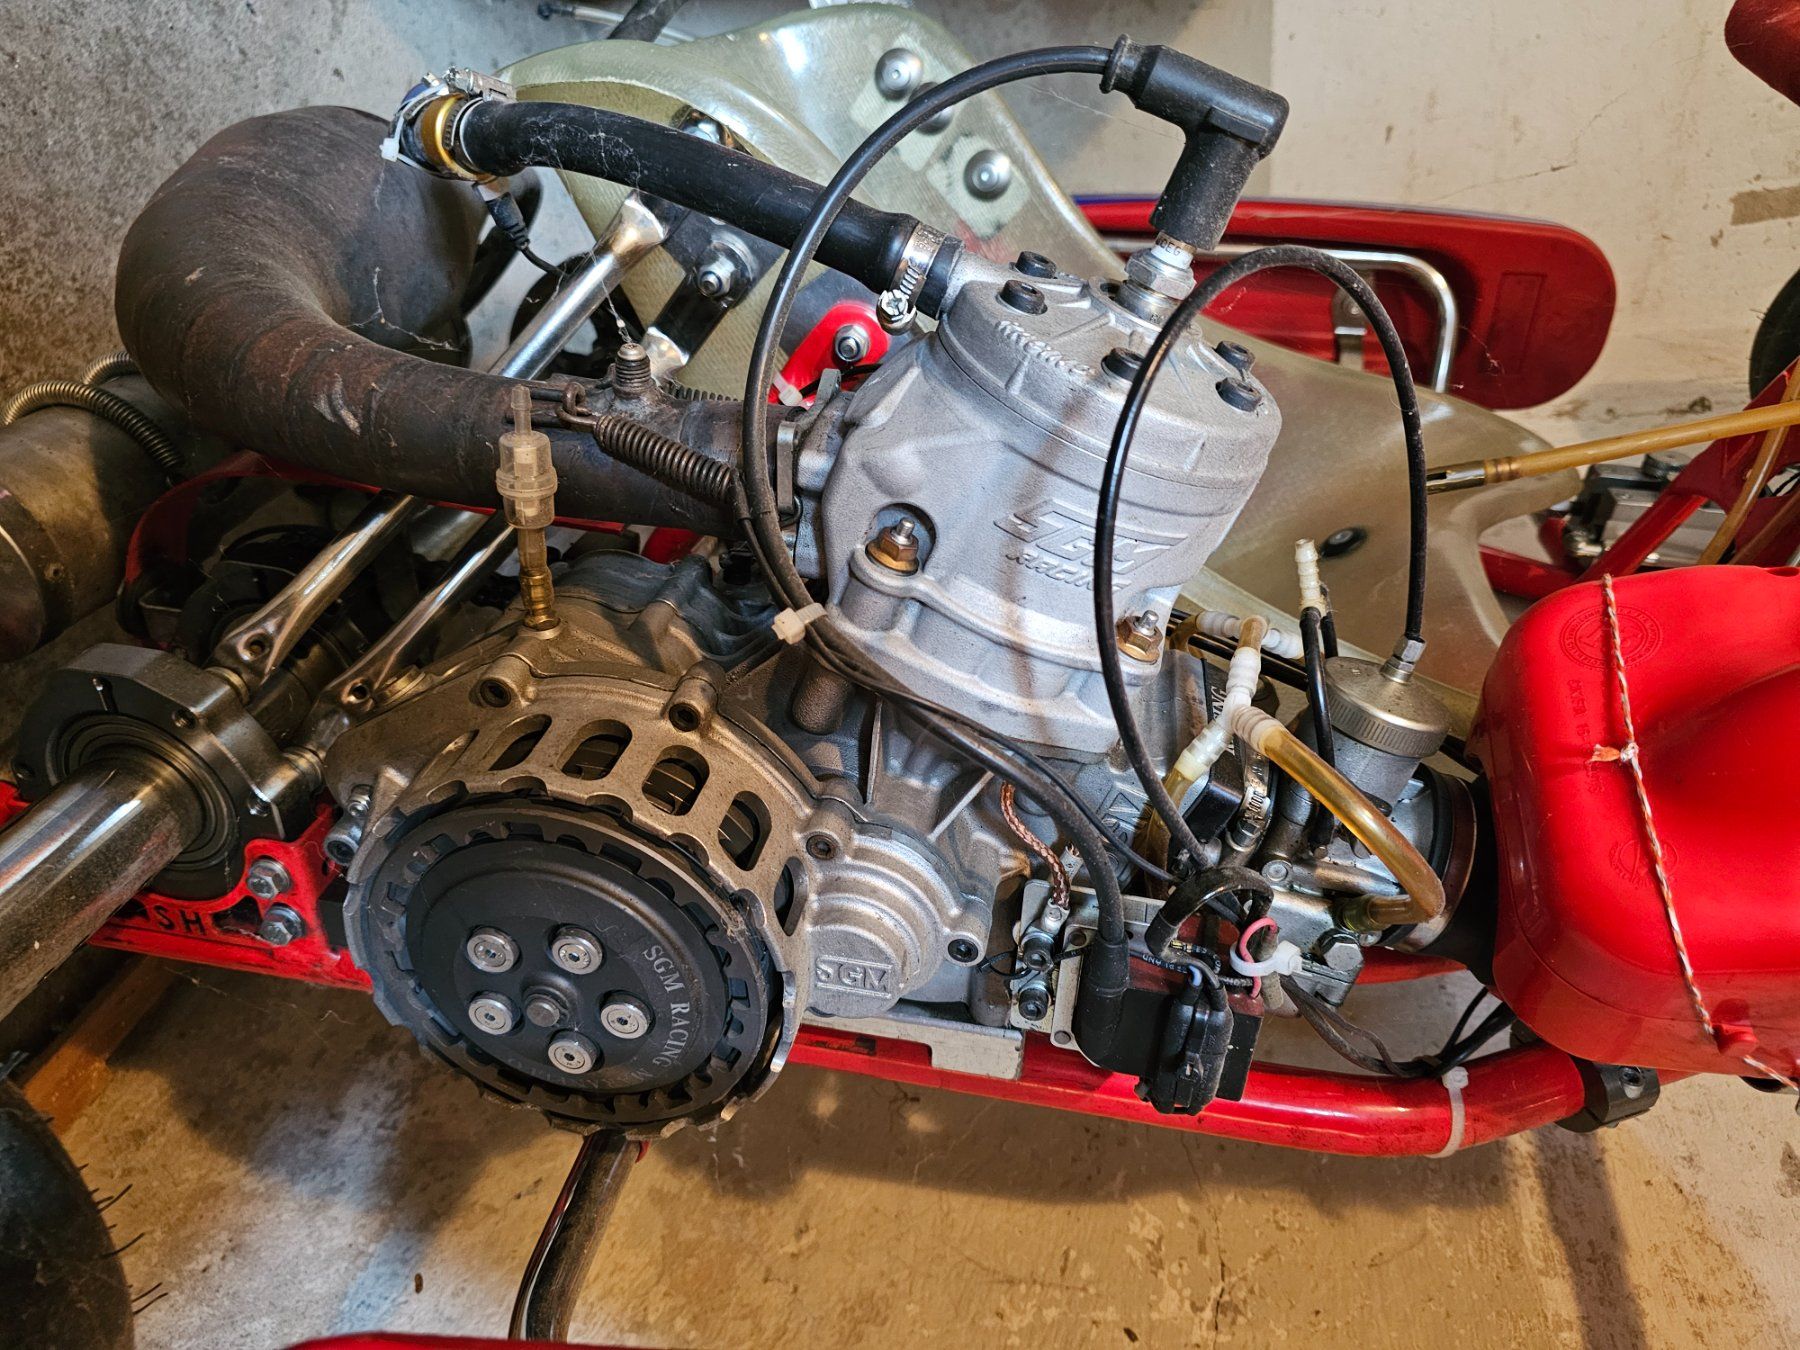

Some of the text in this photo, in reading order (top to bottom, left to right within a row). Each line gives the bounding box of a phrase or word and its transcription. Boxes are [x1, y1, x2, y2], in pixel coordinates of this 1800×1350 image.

[642, 944, 686, 994] SGM
[815, 955, 893, 998] SGM
[652, 1001, 691, 1068] RACING
